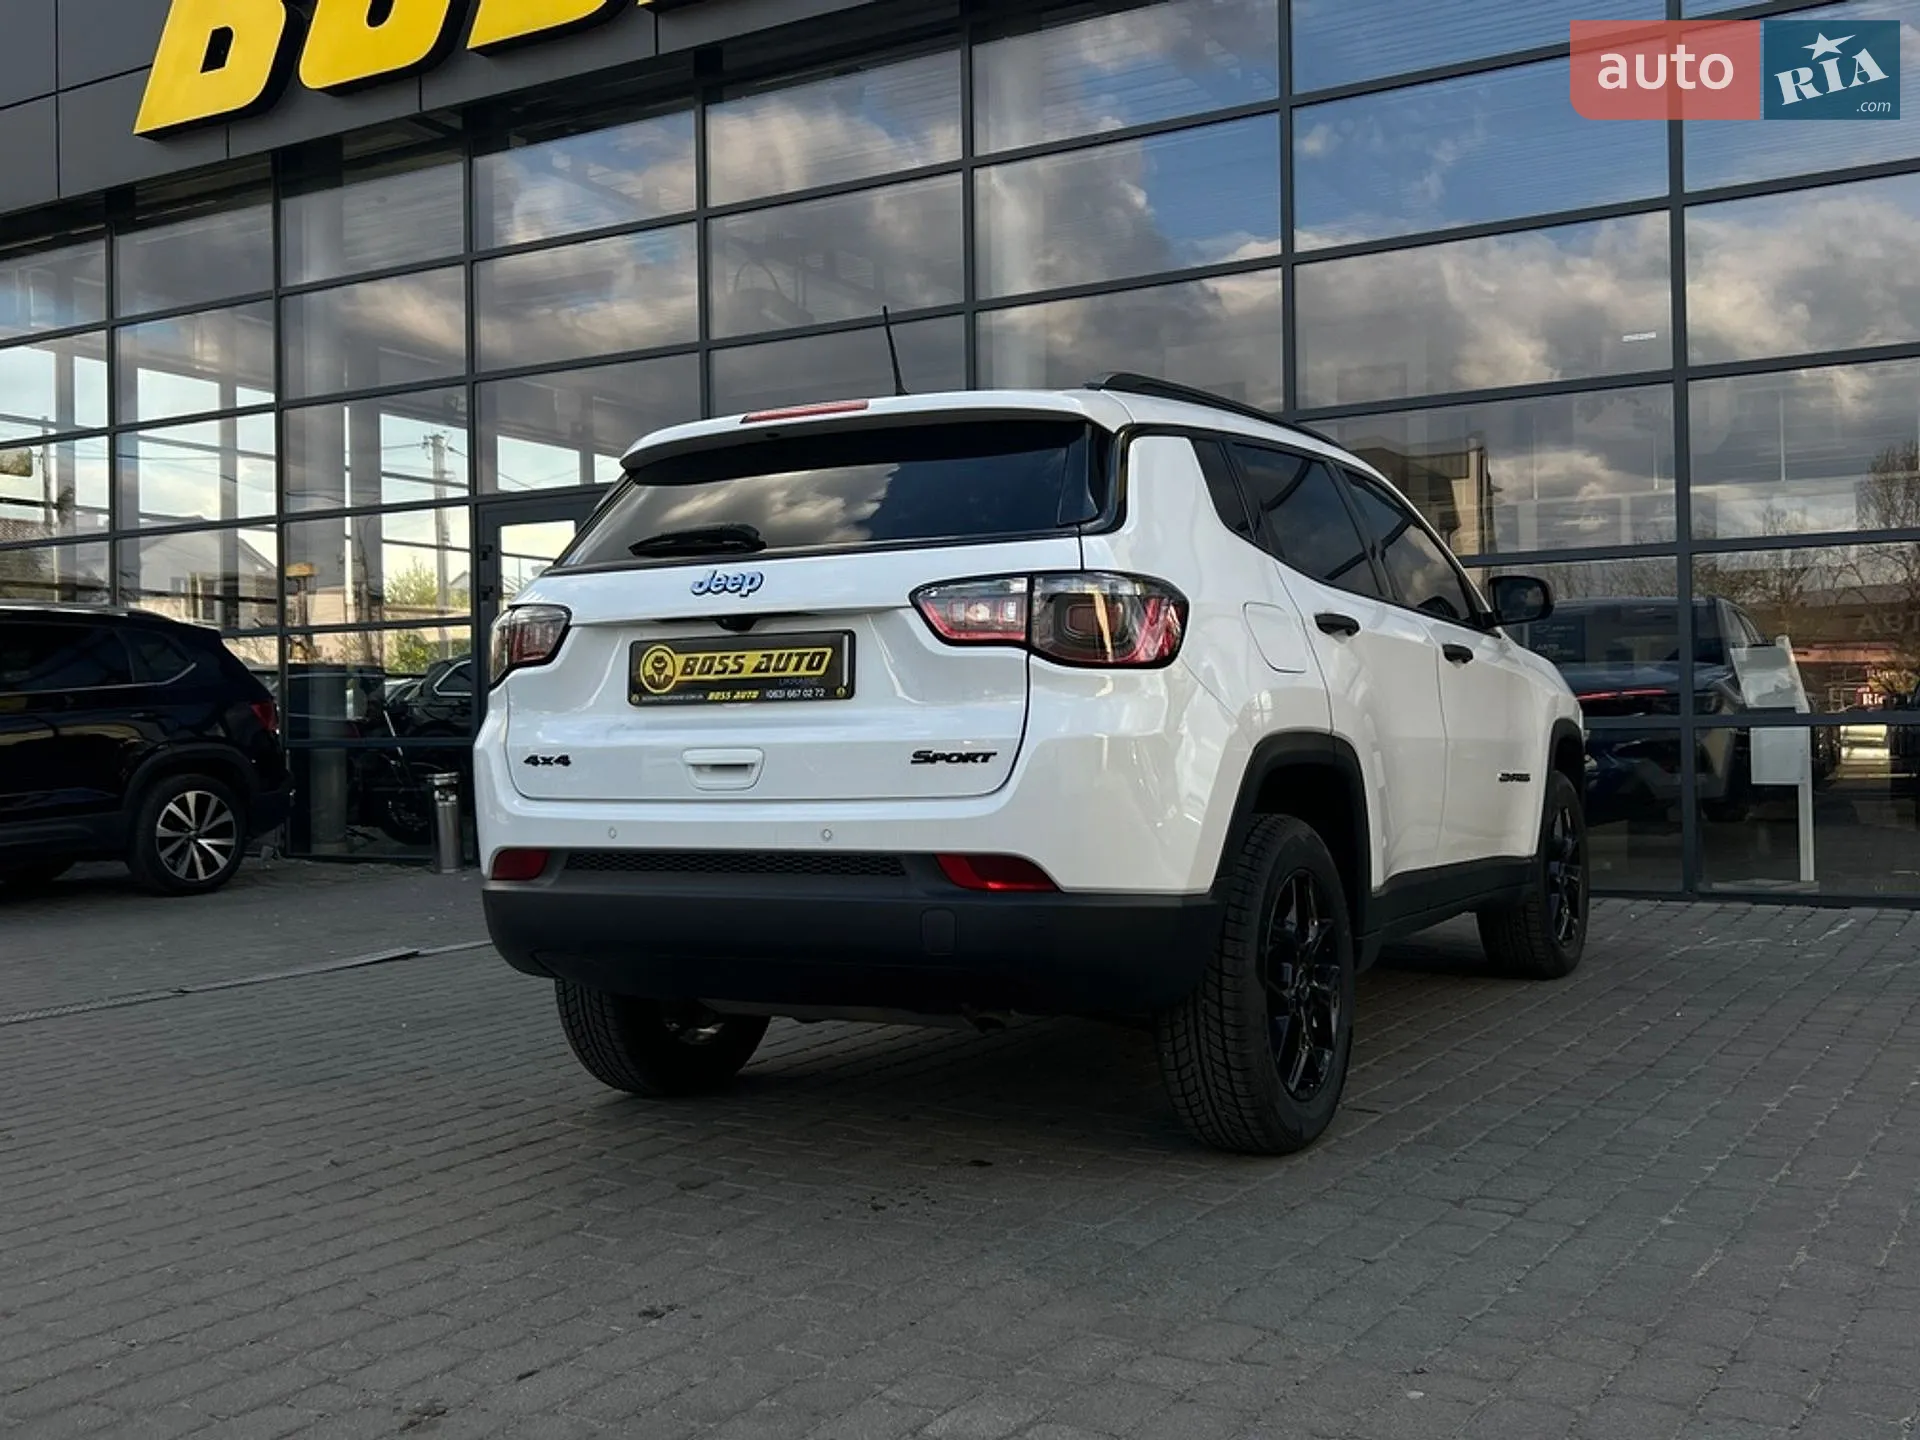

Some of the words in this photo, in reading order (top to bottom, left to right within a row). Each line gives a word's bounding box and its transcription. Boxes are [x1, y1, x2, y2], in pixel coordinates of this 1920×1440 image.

[689, 569, 764, 598] Jeep
[679, 655, 746, 676] BOSS
[751, 651, 828, 674] AUTO
[523, 754, 572, 767] 4x4
